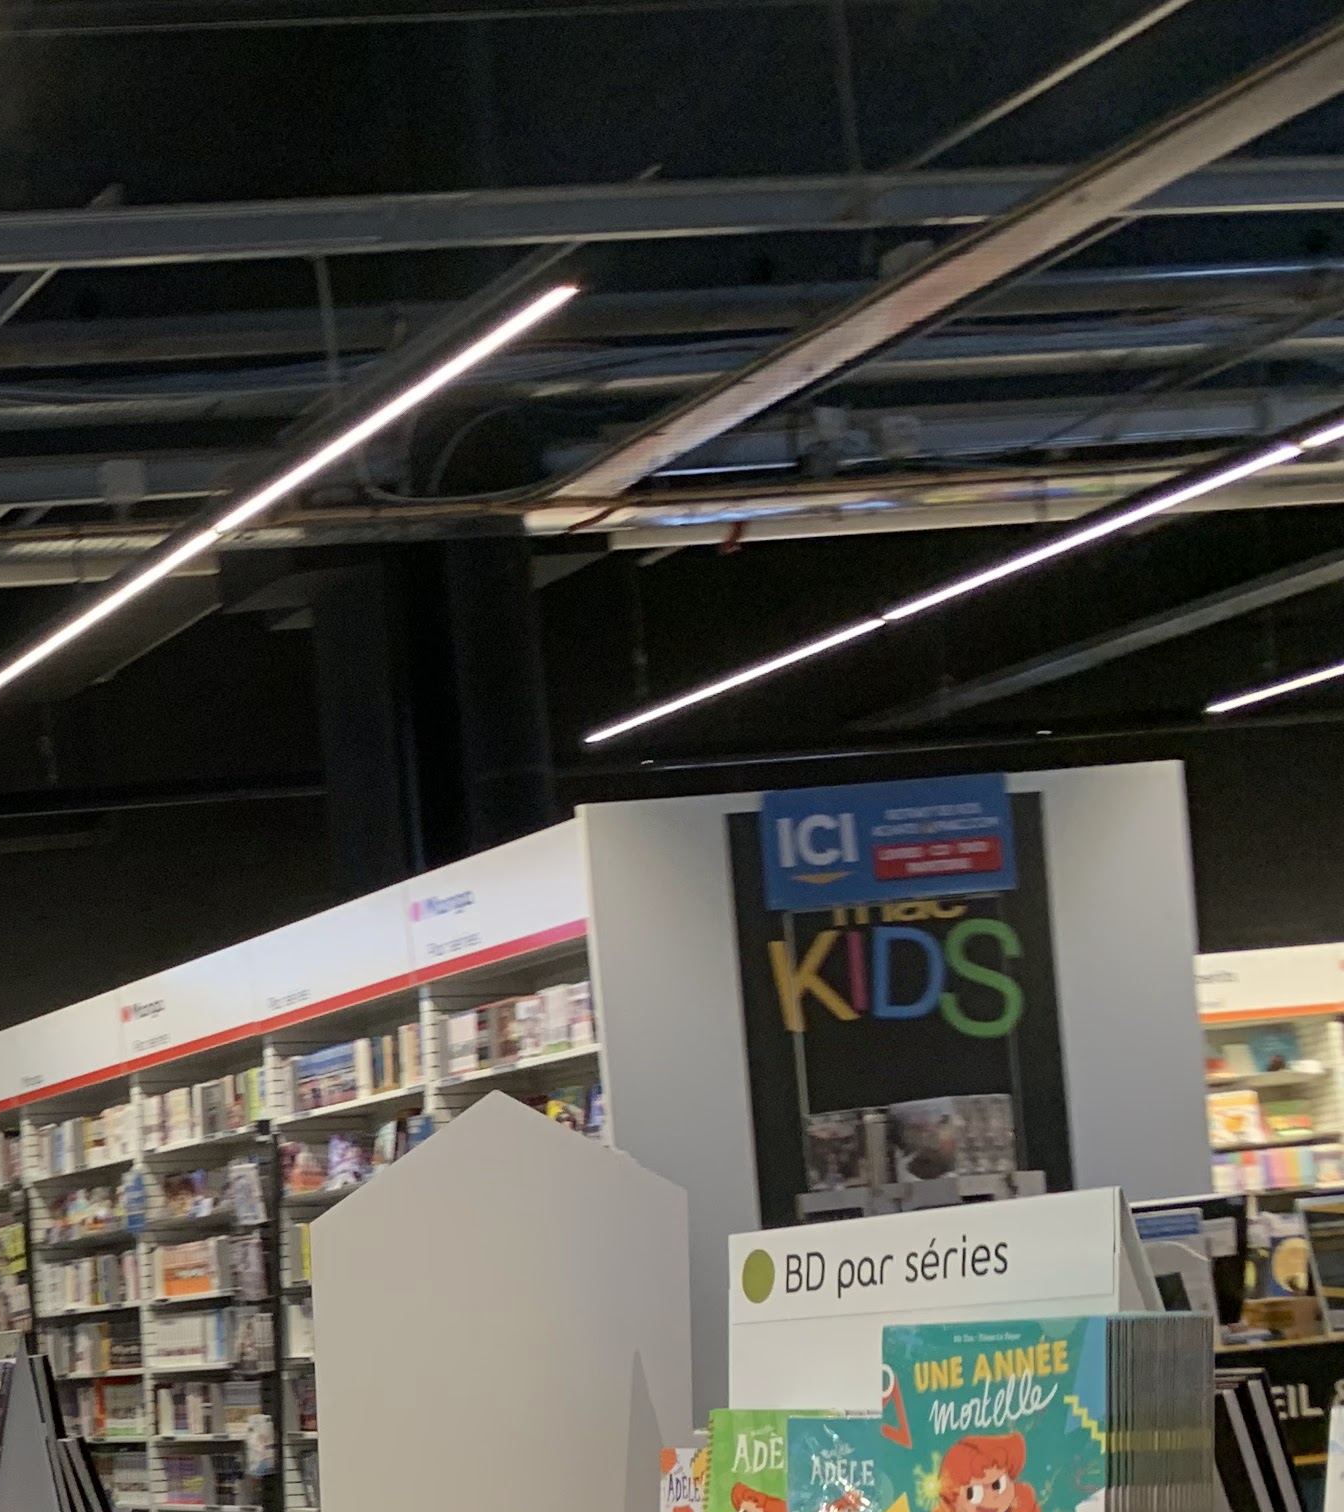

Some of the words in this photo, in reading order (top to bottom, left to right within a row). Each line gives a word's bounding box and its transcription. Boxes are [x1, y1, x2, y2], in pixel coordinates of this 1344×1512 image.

[775, 812, 860, 868] ICI
[767, 918, 1025, 1039] KIDS
[785, 1250, 826, 1293] BD
[837, 1256, 894, 1299] par
[905, 1234, 1010, 1284] séries
[914, 1355, 964, 1393] UNE
[972, 1335, 1070, 1386] ANNÉE
[928, 1367, 1059, 1435] mortelle
[731, 1432, 785, 1474] ADÈ
